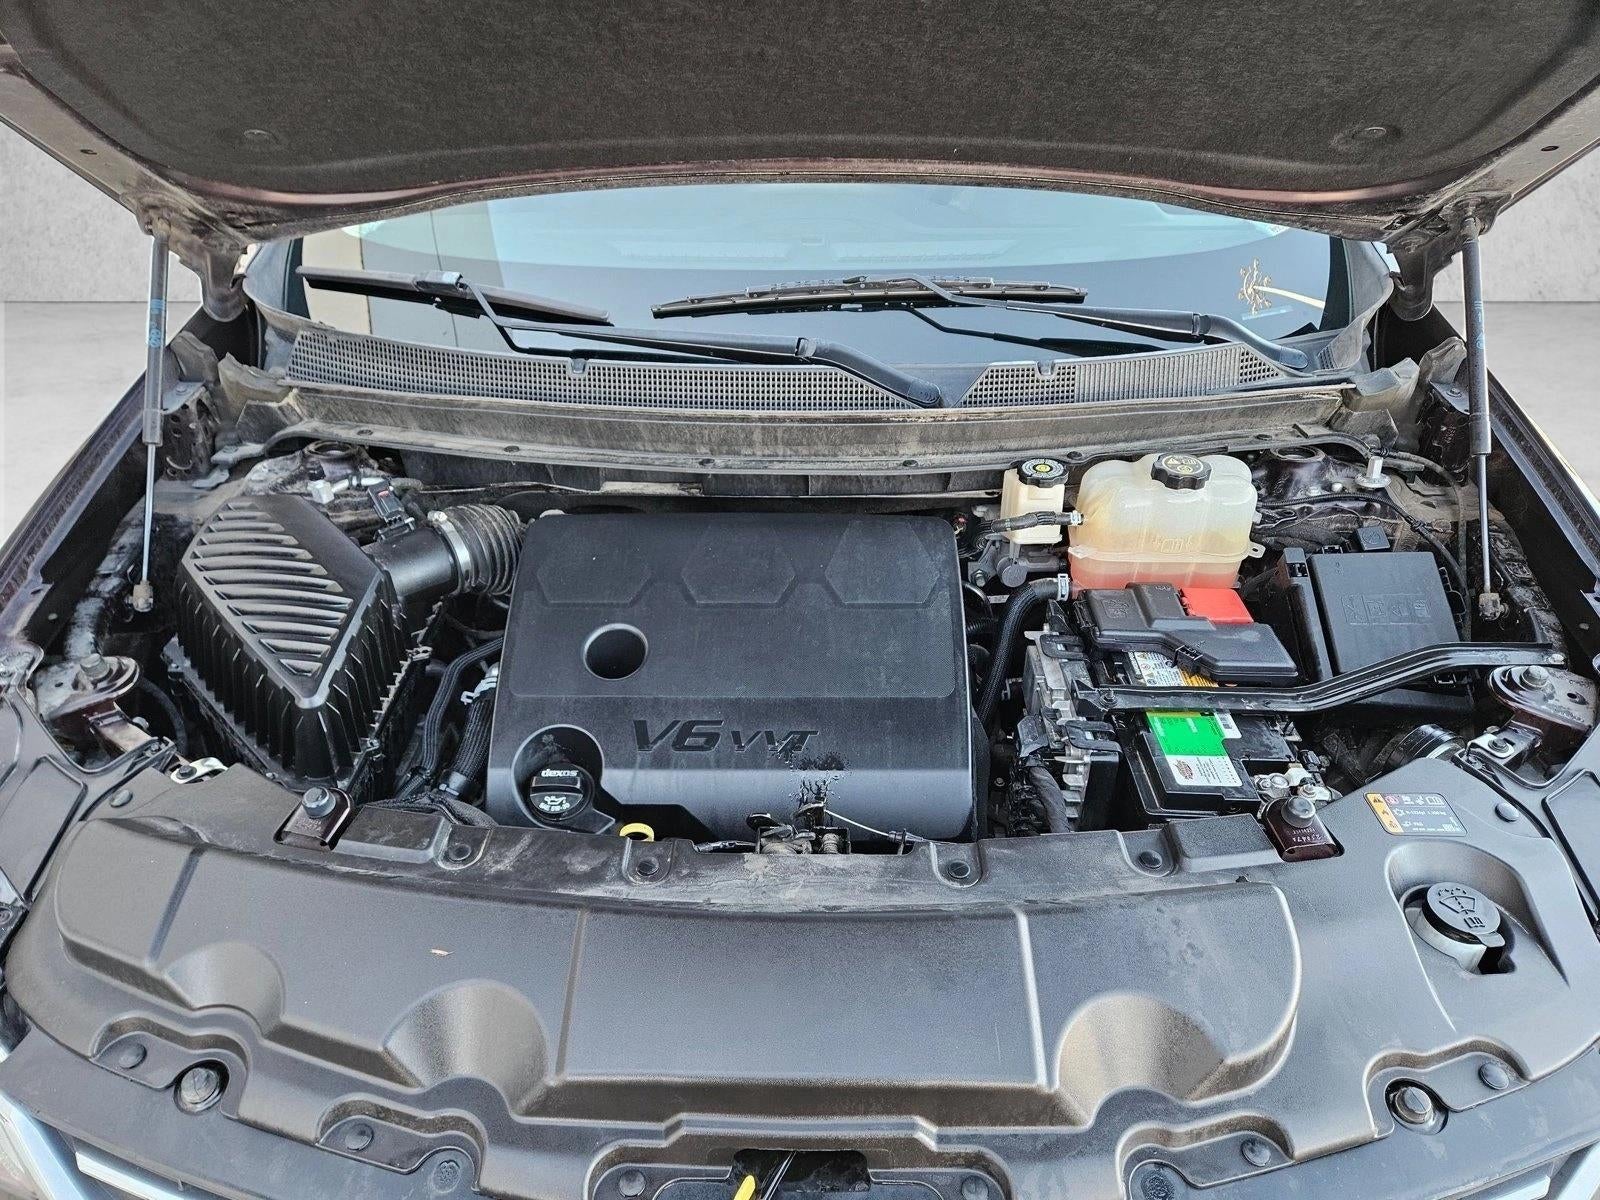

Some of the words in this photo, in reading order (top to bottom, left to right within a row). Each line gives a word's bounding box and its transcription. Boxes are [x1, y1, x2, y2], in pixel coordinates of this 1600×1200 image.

[632, 719, 724, 752] V6
[730, 730, 820, 752] VVT
[541, 768, 579, 777] dexos
